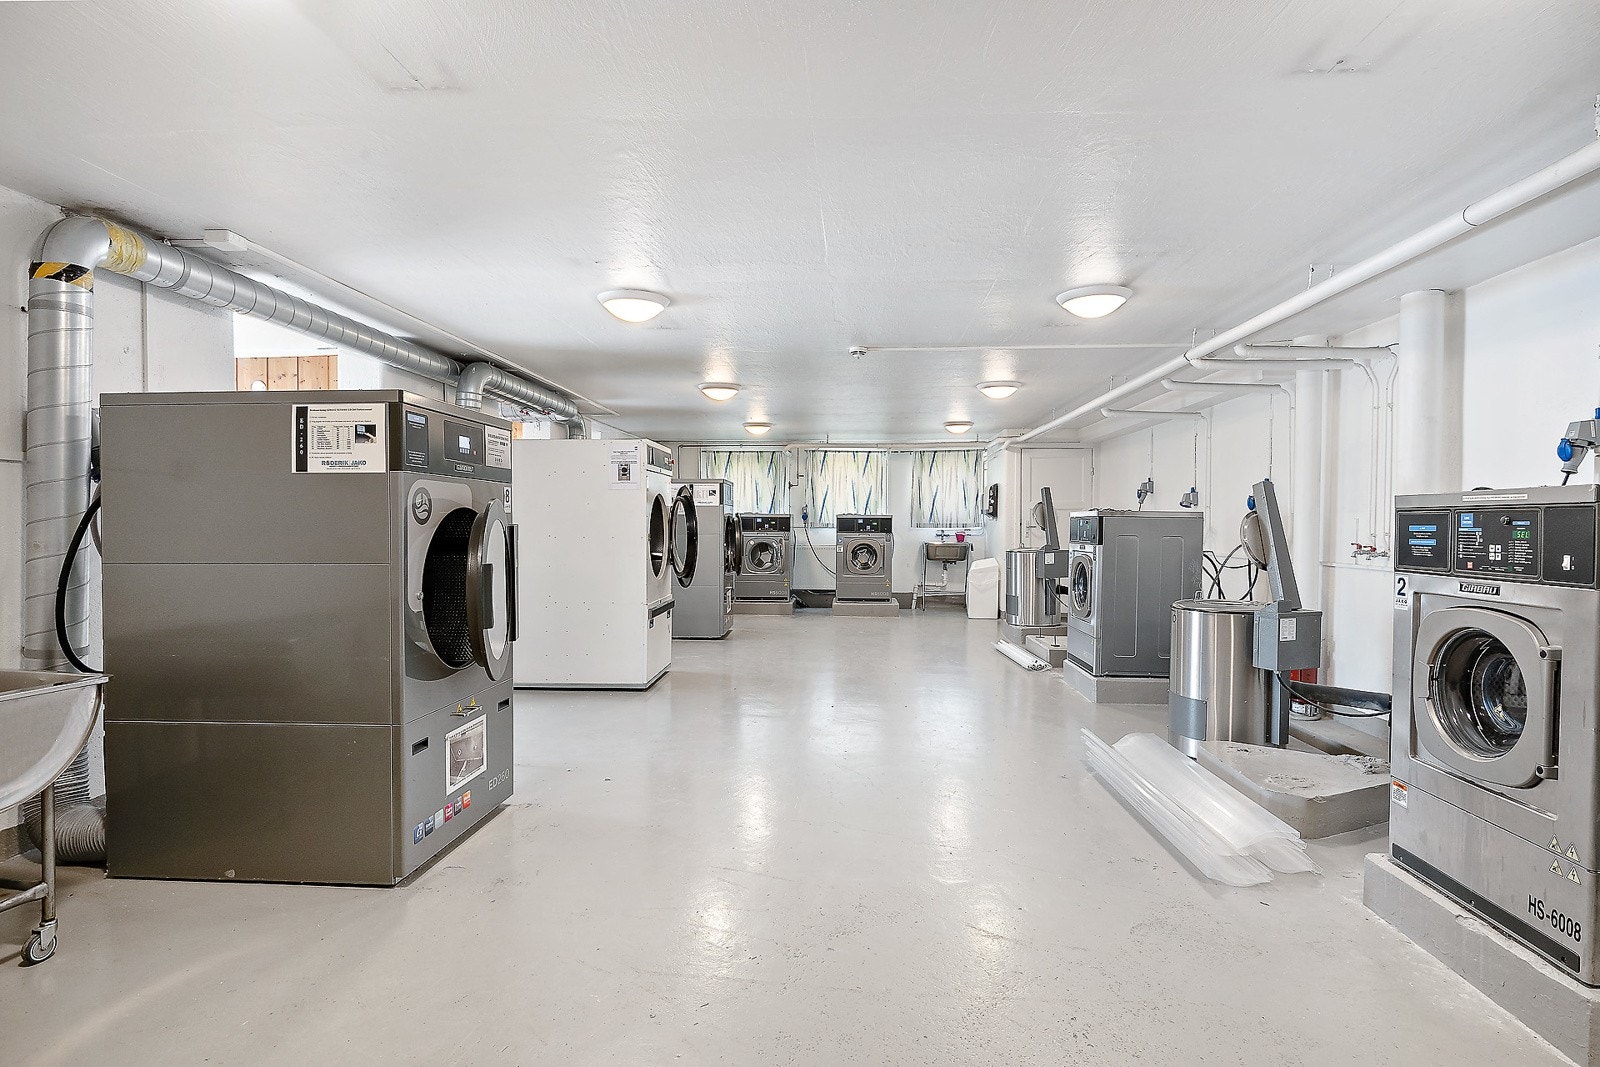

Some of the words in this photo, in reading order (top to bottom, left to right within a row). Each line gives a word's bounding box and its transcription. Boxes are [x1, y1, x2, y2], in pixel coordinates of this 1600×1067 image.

[505, 488, 510, 503] 8
[1517, 530, 1529, 538] SEL
[1397, 577, 1406, 597] 2
[1461, 582, 1498, 595] GIRBAU
[488, 768, 510, 791] ED260
[1528, 894, 1582, 943] HS-6008
